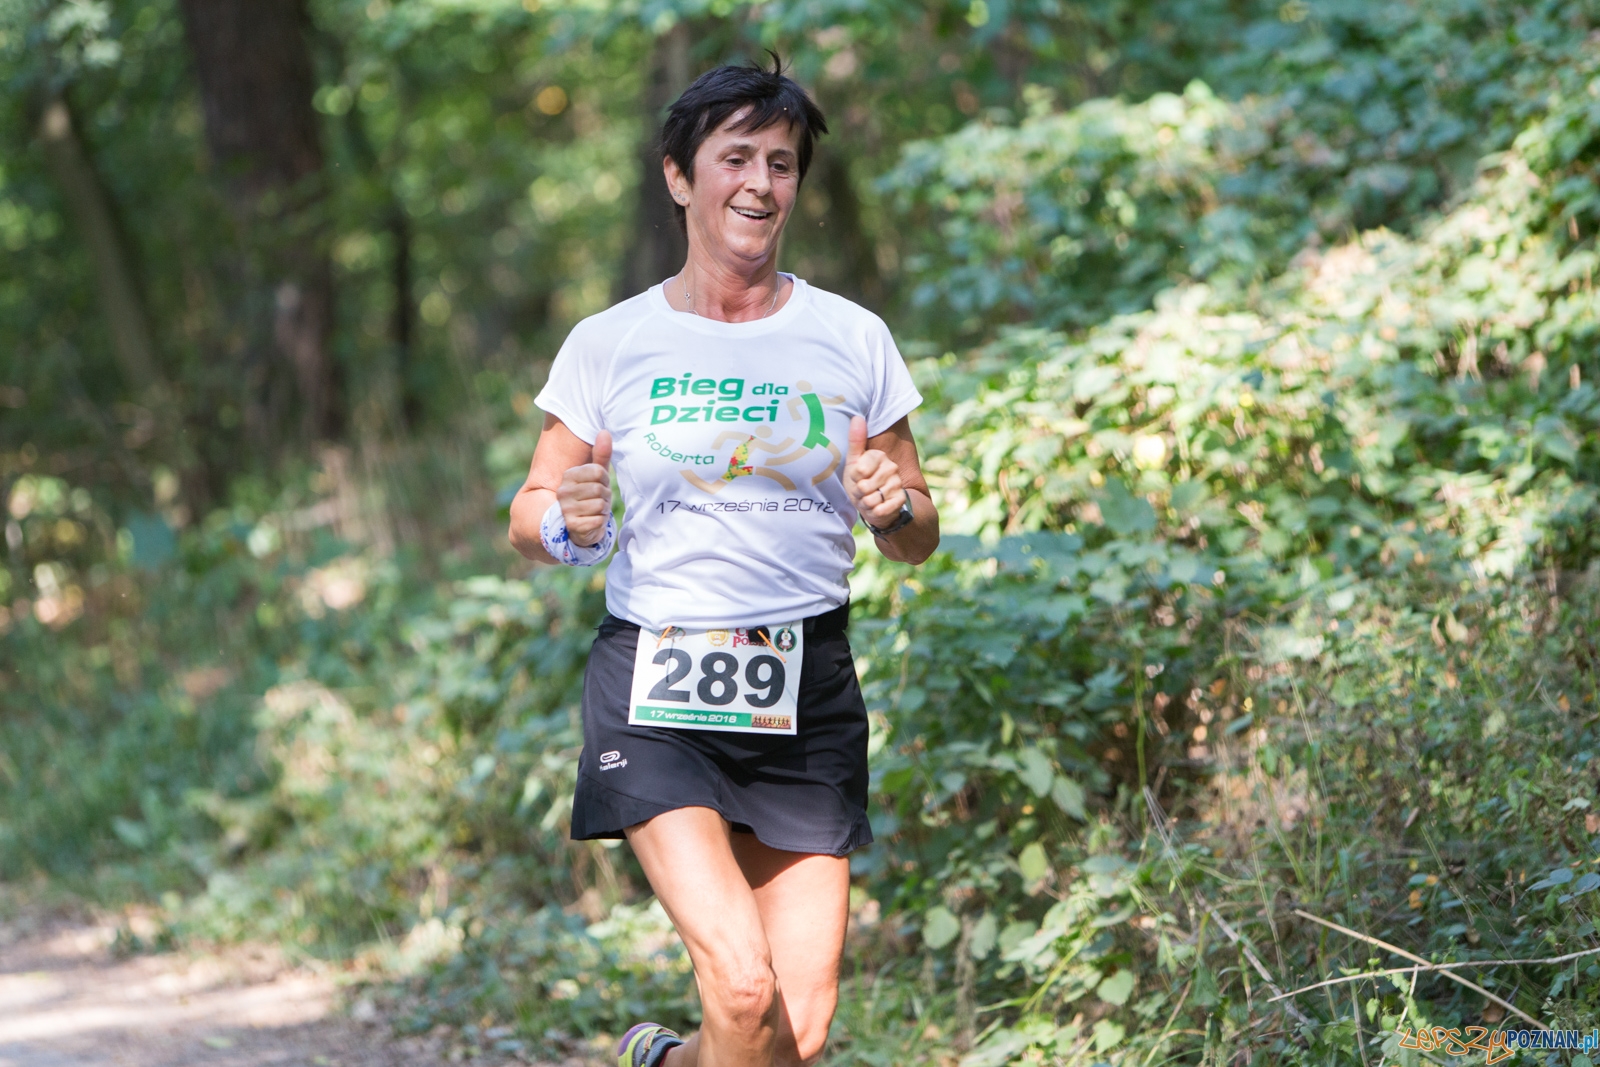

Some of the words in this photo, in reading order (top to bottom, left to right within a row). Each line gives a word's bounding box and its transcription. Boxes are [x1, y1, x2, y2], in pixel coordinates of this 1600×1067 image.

[649, 372, 745, 401] Bieg
[752, 383, 789, 395] dla
[650, 399, 780, 426] Dzieci
[643, 432, 715, 465] Roberta
[656, 500, 681, 514] 17
[685, 498, 779, 513] września
[647, 648, 786, 708] 289
[650, 710, 664, 718] 17
